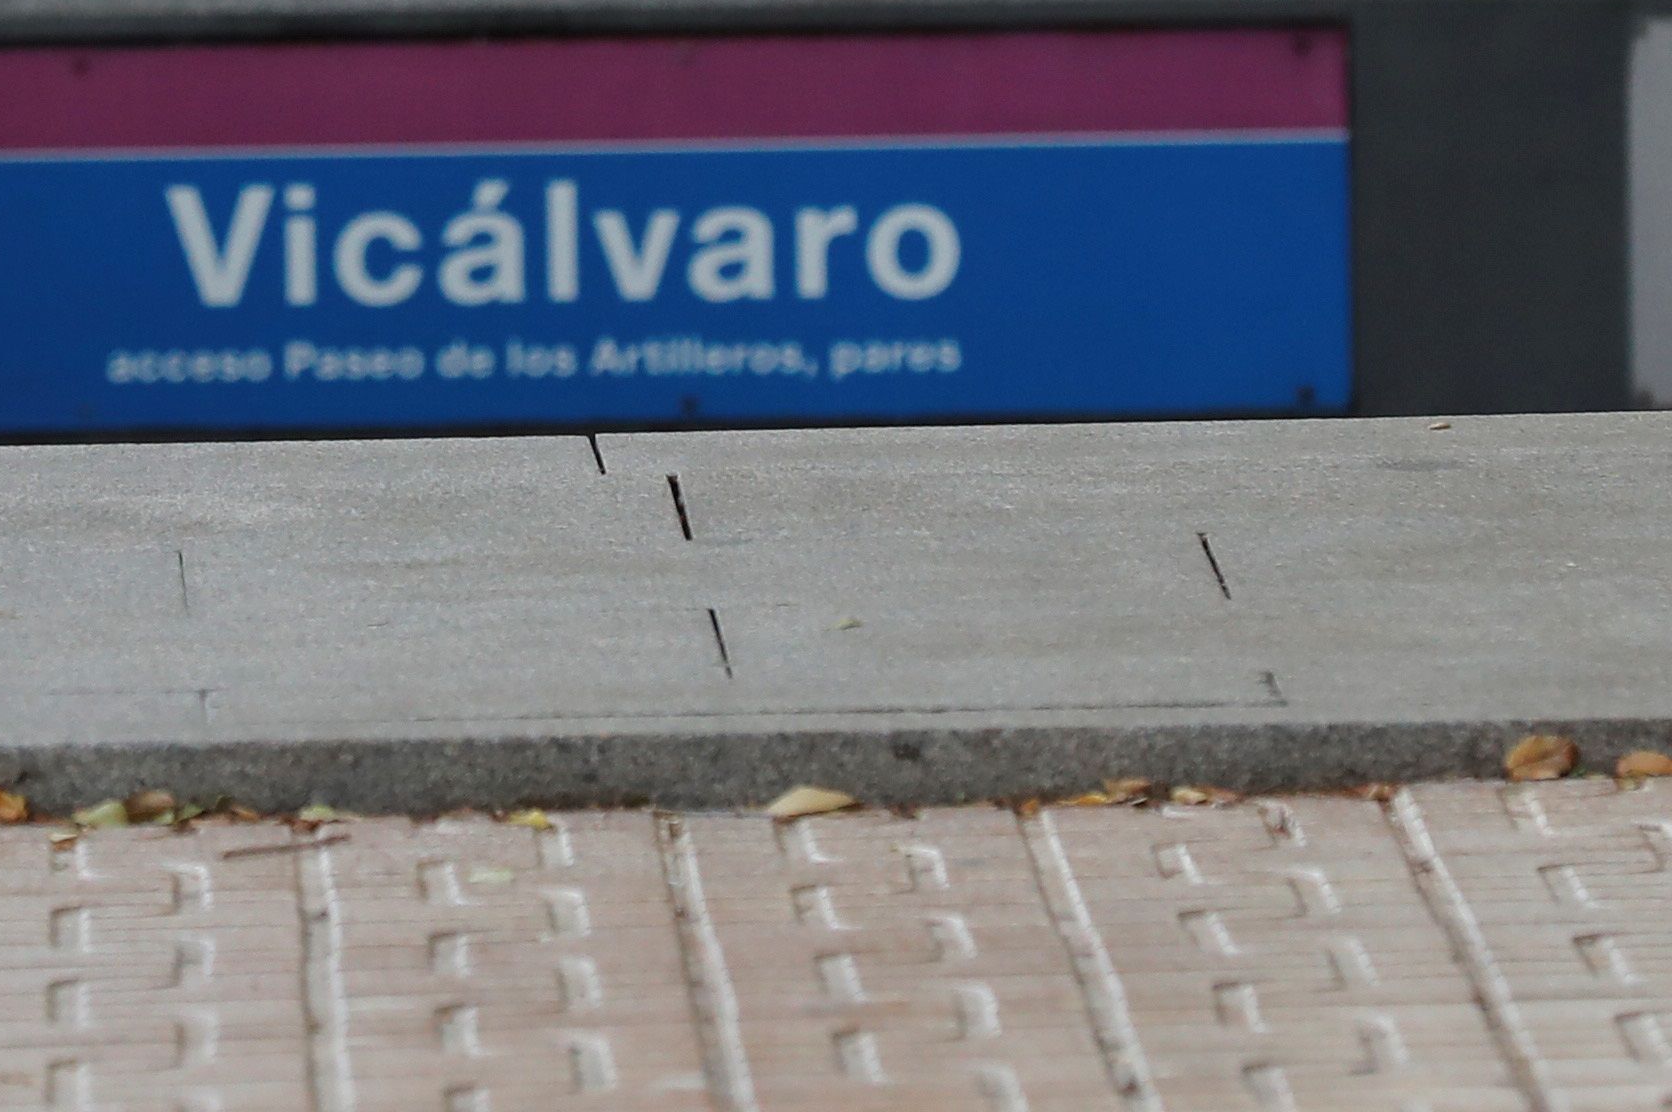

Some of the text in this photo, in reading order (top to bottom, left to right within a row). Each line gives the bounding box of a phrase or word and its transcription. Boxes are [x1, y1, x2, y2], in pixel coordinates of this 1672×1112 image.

[165, 178, 962, 307] Vicálvaro
[108, 336, 963, 383] acceso Paseo de los Artilleros, pares
